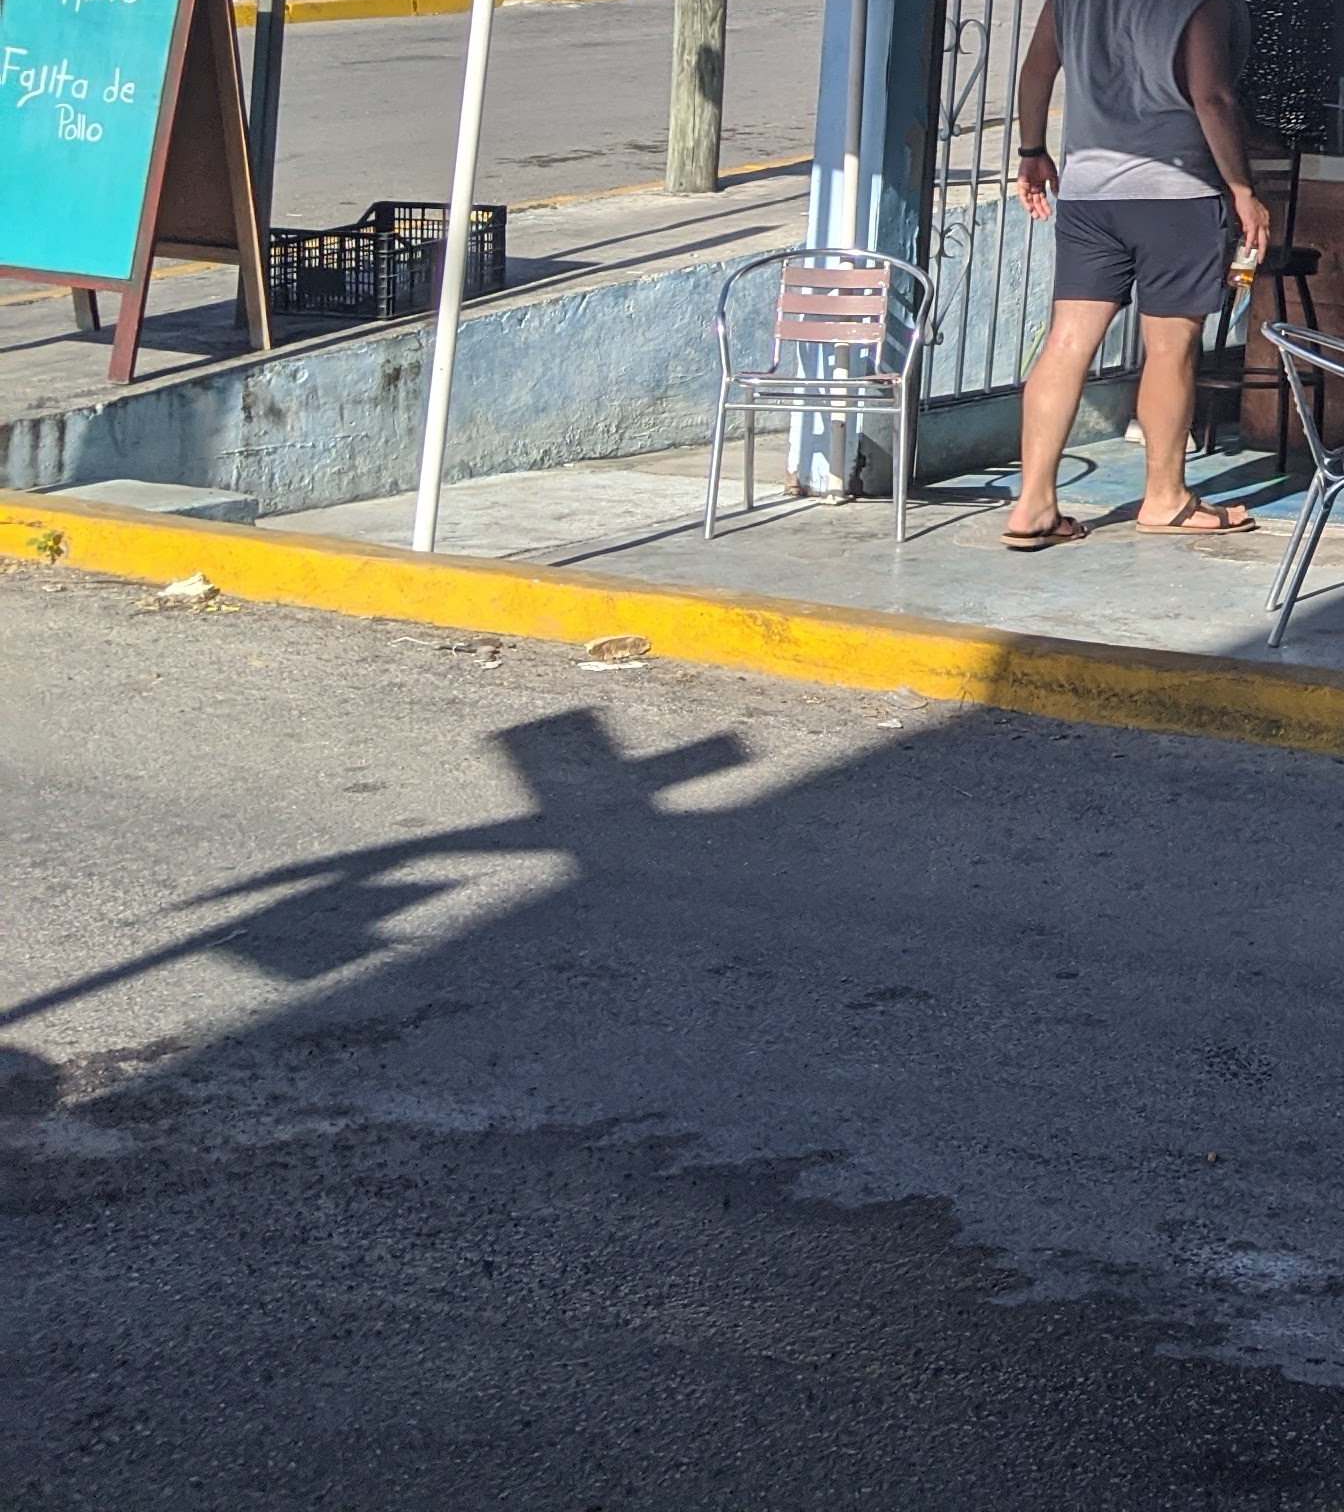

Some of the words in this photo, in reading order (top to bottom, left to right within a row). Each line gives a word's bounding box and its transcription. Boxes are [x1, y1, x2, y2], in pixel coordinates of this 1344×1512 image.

[0, 46, 89, 108] Fajita
[102, 67, 136, 104] de
[55, 103, 103, 142] Pollo
